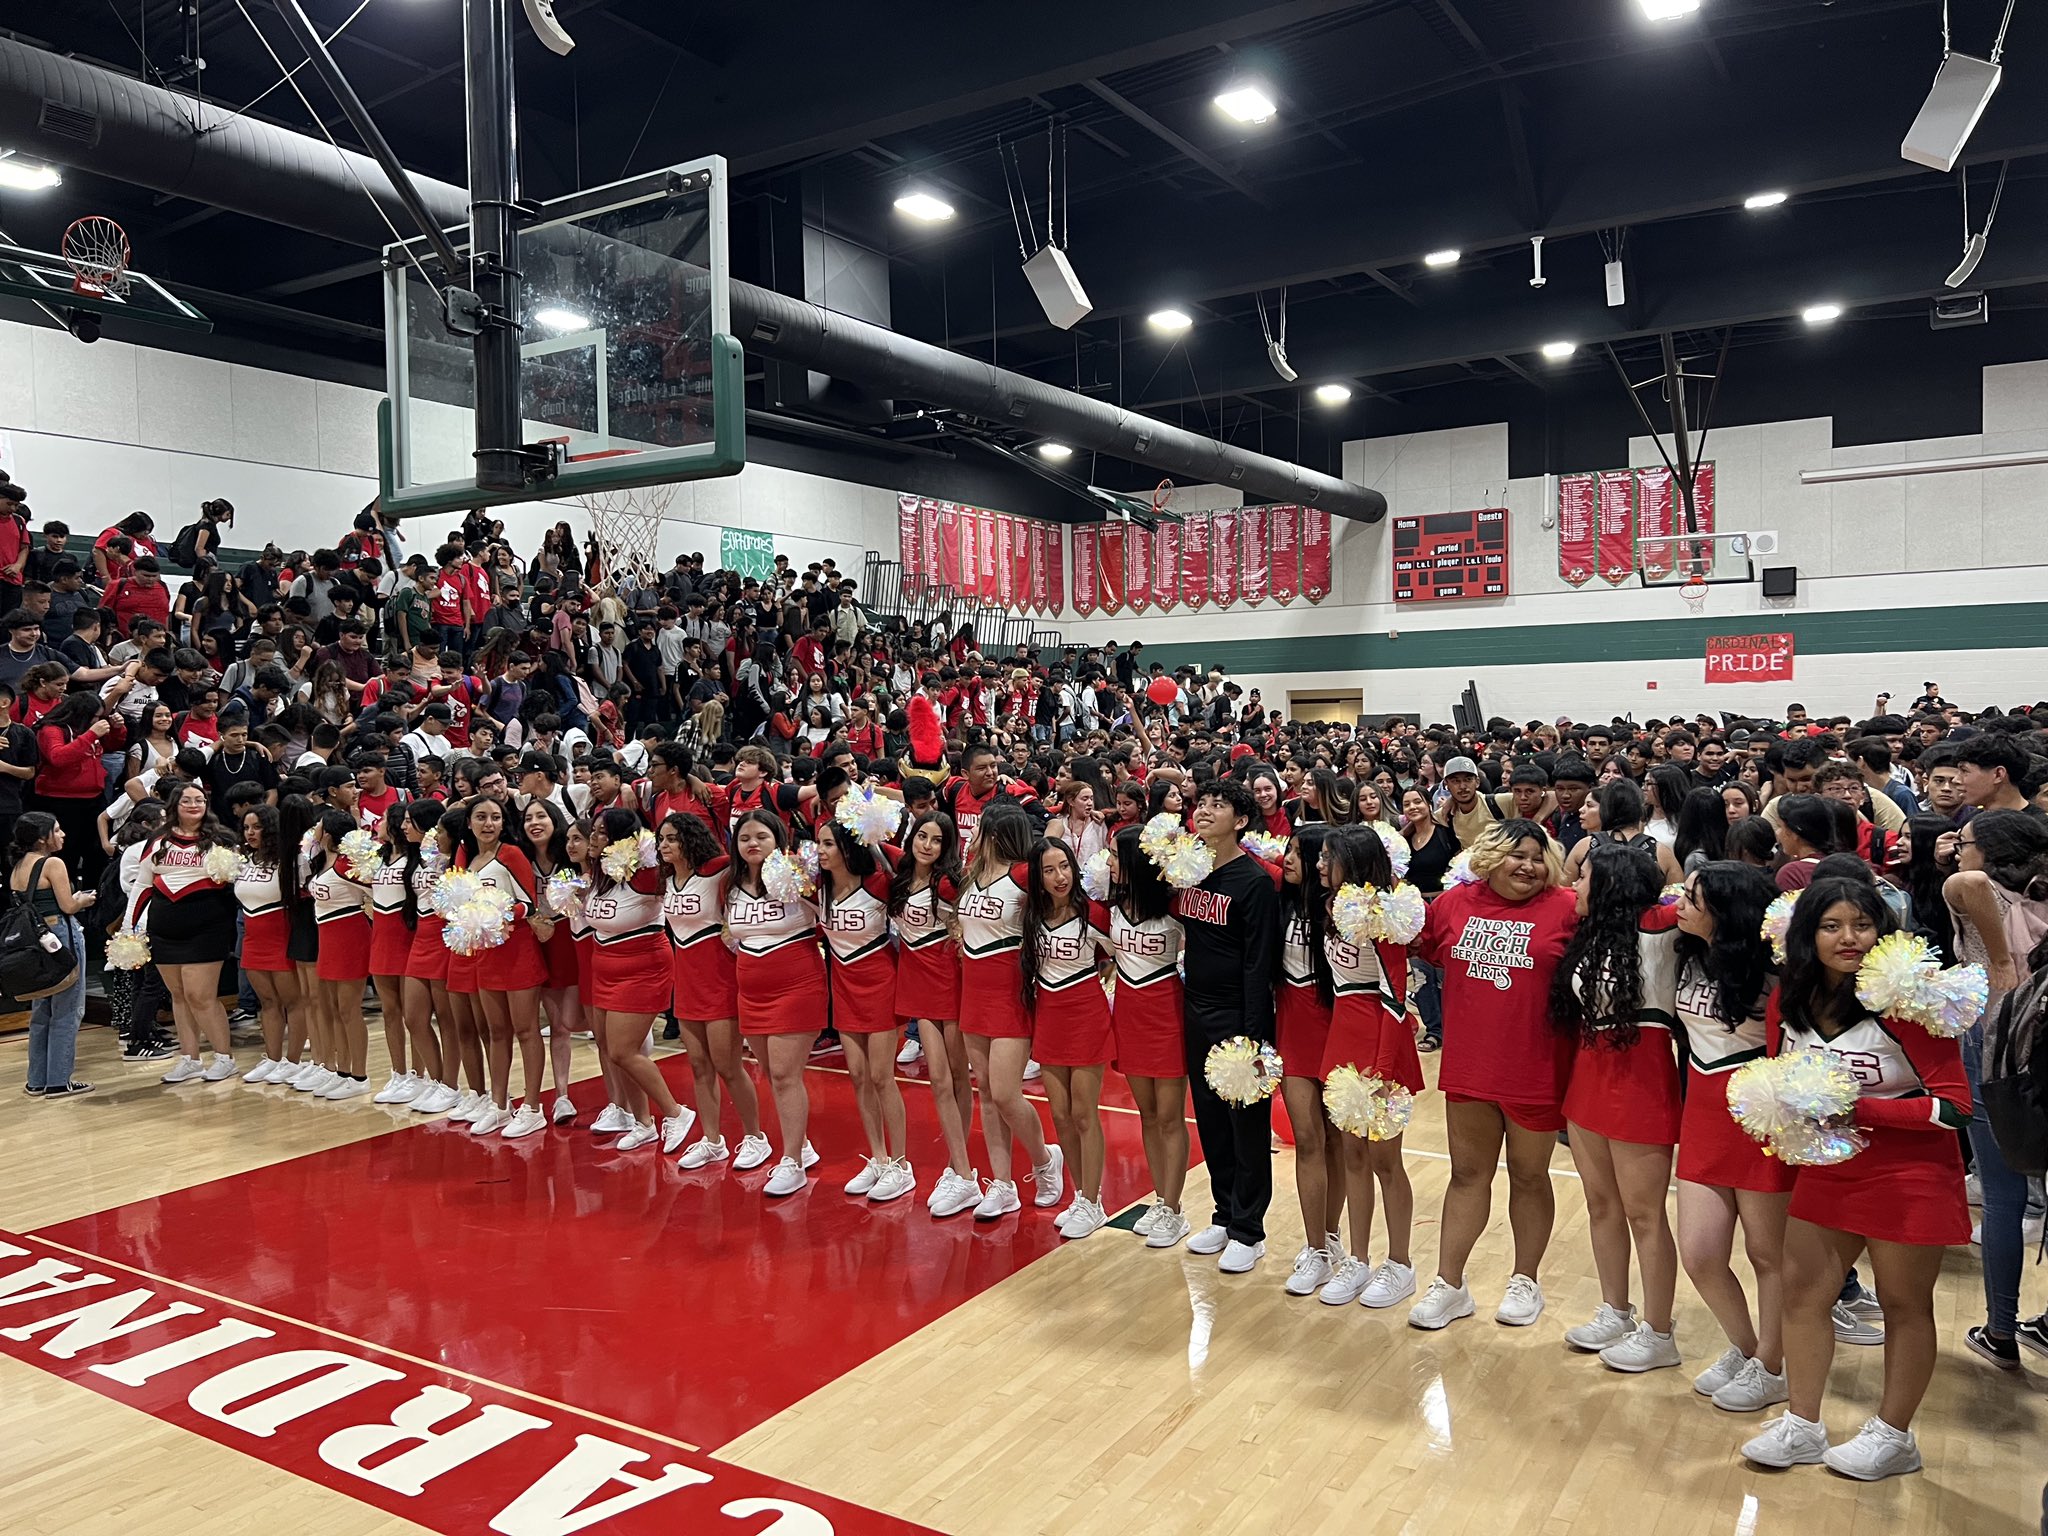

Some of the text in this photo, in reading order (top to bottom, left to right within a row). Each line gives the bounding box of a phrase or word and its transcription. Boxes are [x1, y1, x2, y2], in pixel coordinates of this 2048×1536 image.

[1397, 520, 1416, 529] Home
[1478, 512, 1503, 521] Guests
[1437, 544, 1459, 554] period
[1396, 562, 1412, 570] fouls
[1437, 558, 1460, 568] player
[1485, 554, 1502, 563] fouls
[1439, 587, 1457, 596] game
[1487, 584, 1501, 592] won
[729, 900, 785, 926] LHS
[1467, 916, 1535, 937] LINDSAY
[1458, 929, 1531, 957] HIGH
[1451, 945, 1534, 970] PERFORMING
[1466, 962, 1512, 991] ARTS
